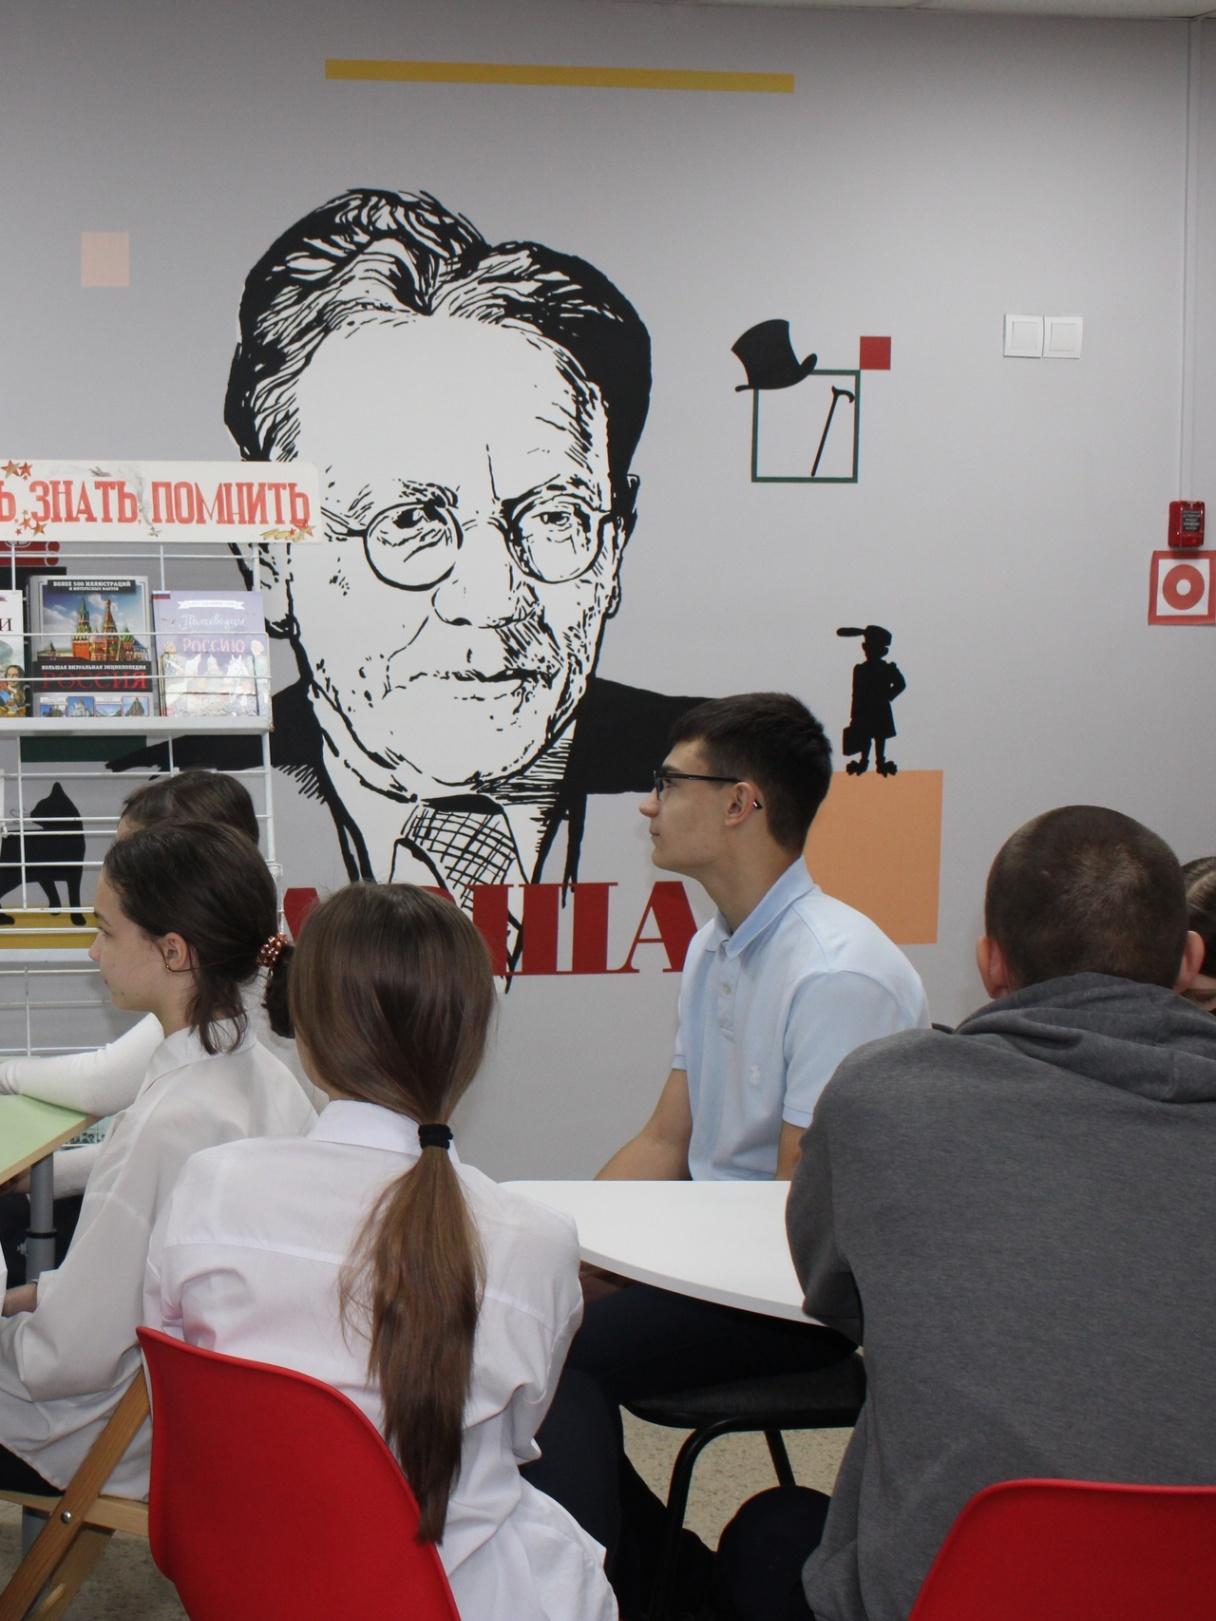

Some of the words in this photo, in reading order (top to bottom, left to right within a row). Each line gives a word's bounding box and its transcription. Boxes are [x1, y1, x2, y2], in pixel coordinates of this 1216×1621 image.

[150, 480, 312, 527] ПОМНИТЬ
[183, 638, 245, 654] РОССИЮ
[42, 671, 149, 689] РОССИЯ
